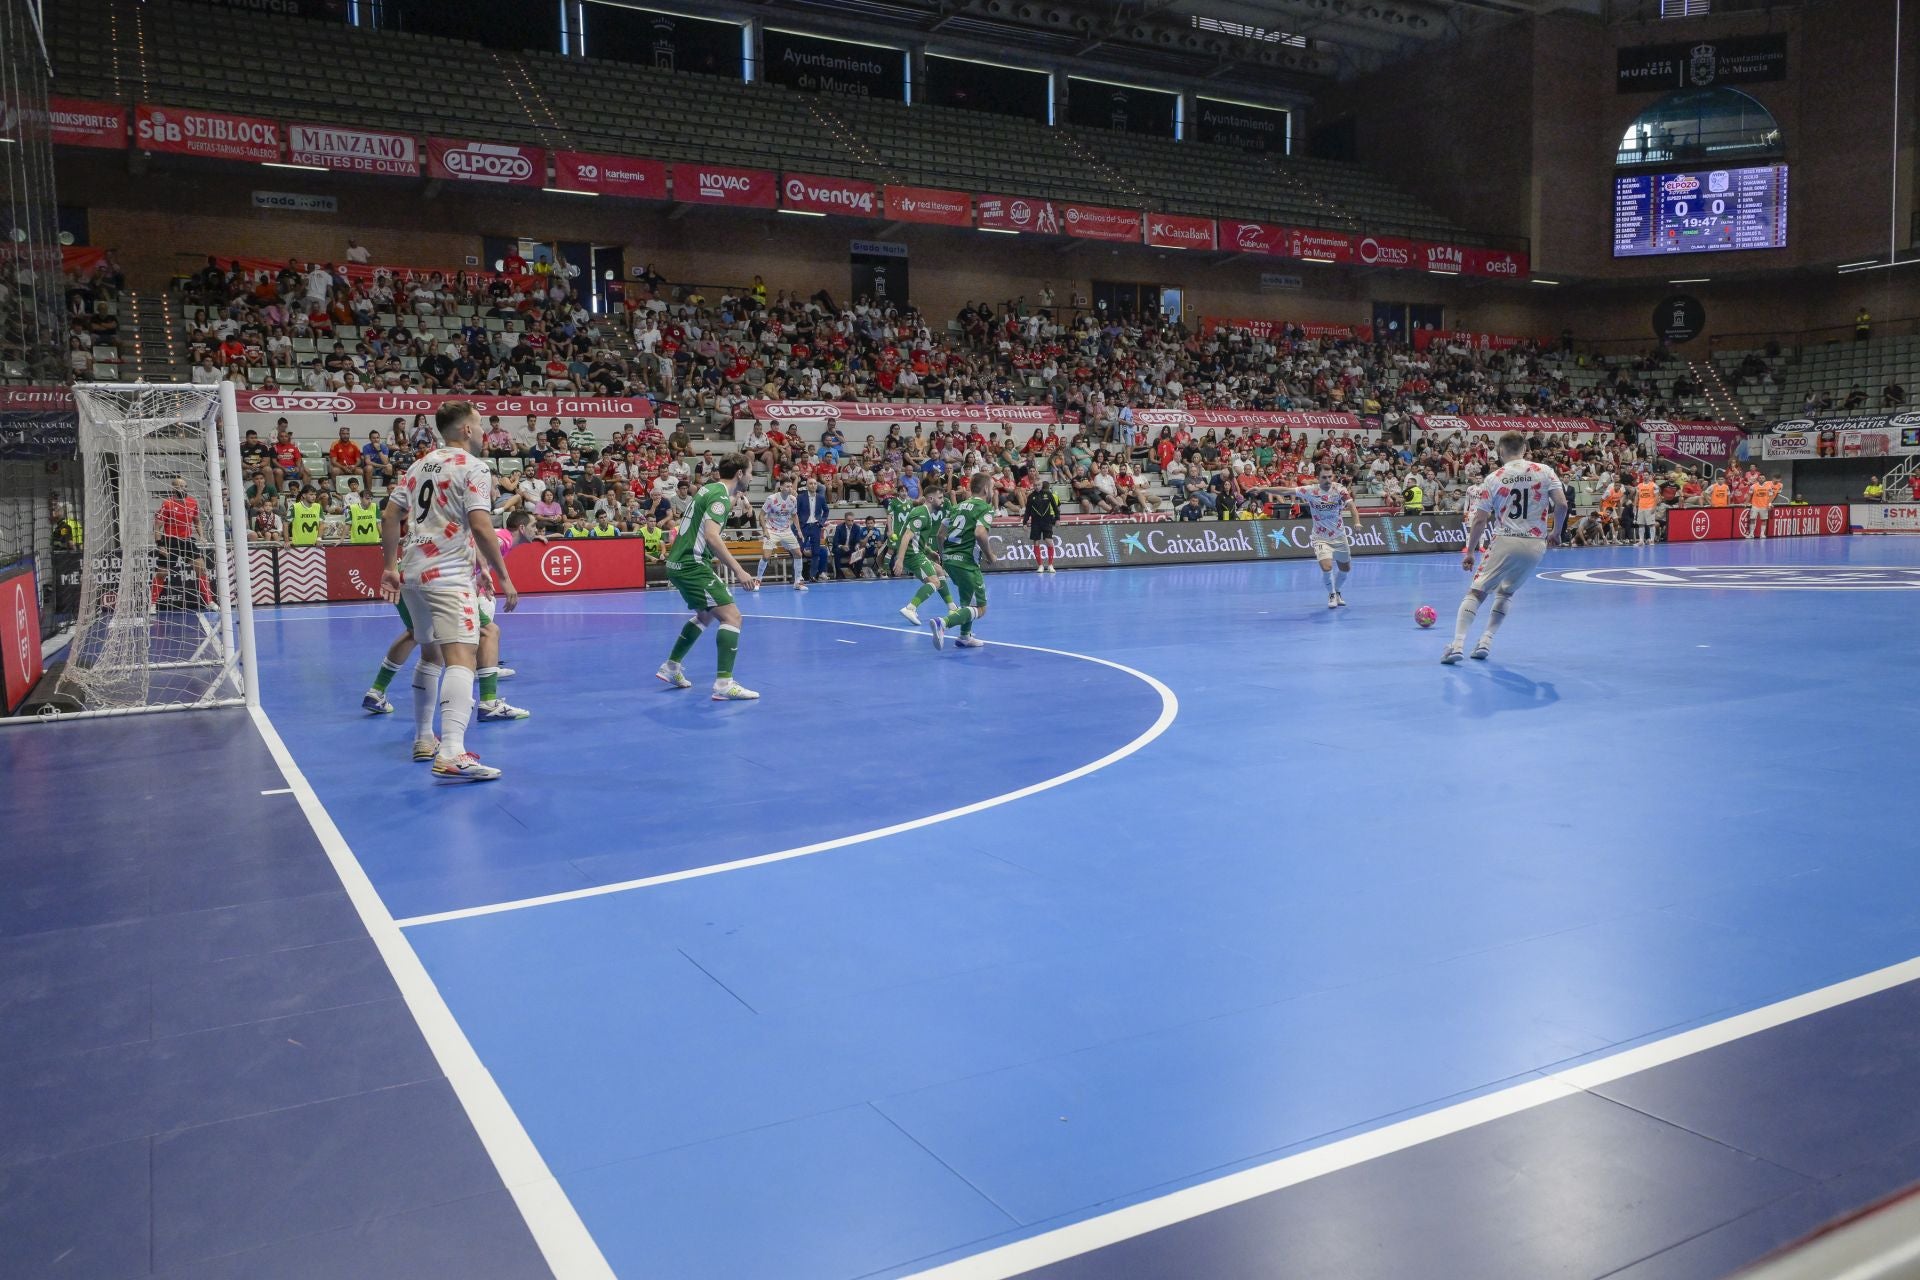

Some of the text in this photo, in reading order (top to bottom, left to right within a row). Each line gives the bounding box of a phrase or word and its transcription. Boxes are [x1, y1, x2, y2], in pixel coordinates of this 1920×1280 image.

[783, 48, 882, 76] Ayuntamiento
[1719, 52, 1784, 65] Ayuntamiento
[1620, 66, 1673, 79] MURCIA
[1719, 63, 1768, 75] de Murcia
[799, 75, 869, 96] de Murcia
[1203, 109, 1275, 132] Ayuntamiento
[184, 116, 277, 146] SEIBLOCK
[301, 128, 405, 160] MANZANO
[292, 152, 417, 175] ACEITES DE OLIVA
[605, 169, 645, 182] karkemis
[700, 173, 750, 191] NOVAC
[808, 186, 873, 212] venty4
[1712, 199, 1725, 215] 0
[1675, 201, 1688, 217] 0
[1683, 216, 1718, 228] 19:47
[1165, 225, 1211, 240] CaixaBank
[1704, 228, 1711, 236] 2
[1303, 235, 1348, 248] Ayuntamiento
[1303, 248, 1337, 258] de Murcia
[379, 396, 431, 411] Uno
[496, 399, 521, 412] de
[531, 400, 548, 412] la
[555, 398, 633, 416] familia
[856, 403, 895, 417] Uno
[901, 405, 936, 418] más
[941, 404, 961, 417] de
[964, 406, 980, 418] la
[984, 405, 1042, 420] familia
[1204, 411, 1236, 424] Uno
[1270, 412, 1288, 424] de
[1290, 412, 1301, 425] la
[1302, 412, 1349, 427] familia
[1474, 416, 1501, 429] Uno
[1527, 418, 1541, 429] de
[1543, 418, 1552, 429] la
[1553, 418, 1589, 431] familia
[1814, 420, 1888, 432] COMPARTIR
[1677, 443, 1709, 455] SIEMPRE
[421, 463, 442, 474] Rafa
[1502, 475, 1532, 485] Gadeia
[416, 479, 434, 525] 9
[1508, 488, 1529, 520] 31
[1774, 507, 1820, 517] DIVISIÓN
[948, 515, 966, 544] 2
[1773, 516, 1820, 536] FÚTBOL SALA
[987, 534, 1105, 561] CaixaBank
[1146, 530, 1253, 555] CaixaBank
[348, 568, 375, 598] SUELA
